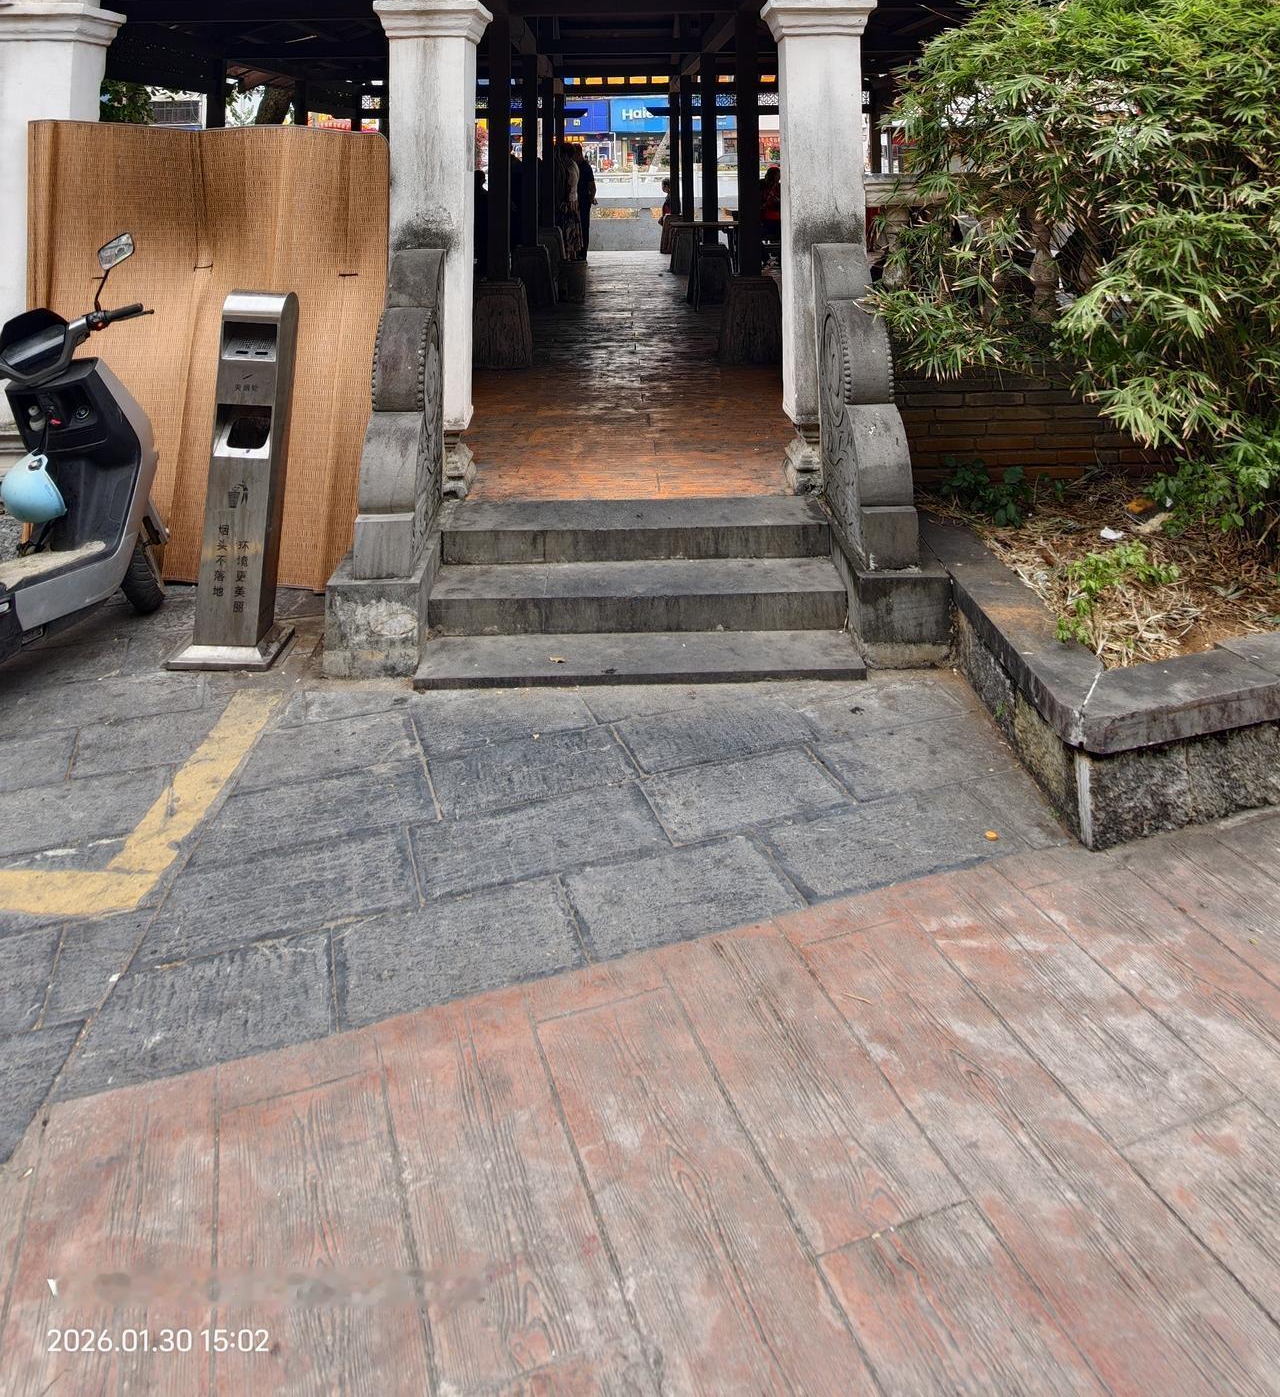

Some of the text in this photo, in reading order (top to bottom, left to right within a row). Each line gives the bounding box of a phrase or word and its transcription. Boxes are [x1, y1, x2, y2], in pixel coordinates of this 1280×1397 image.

[212, 524, 230, 597] 烟头不落地
[232, 540, 250, 613] 环境更美丽
